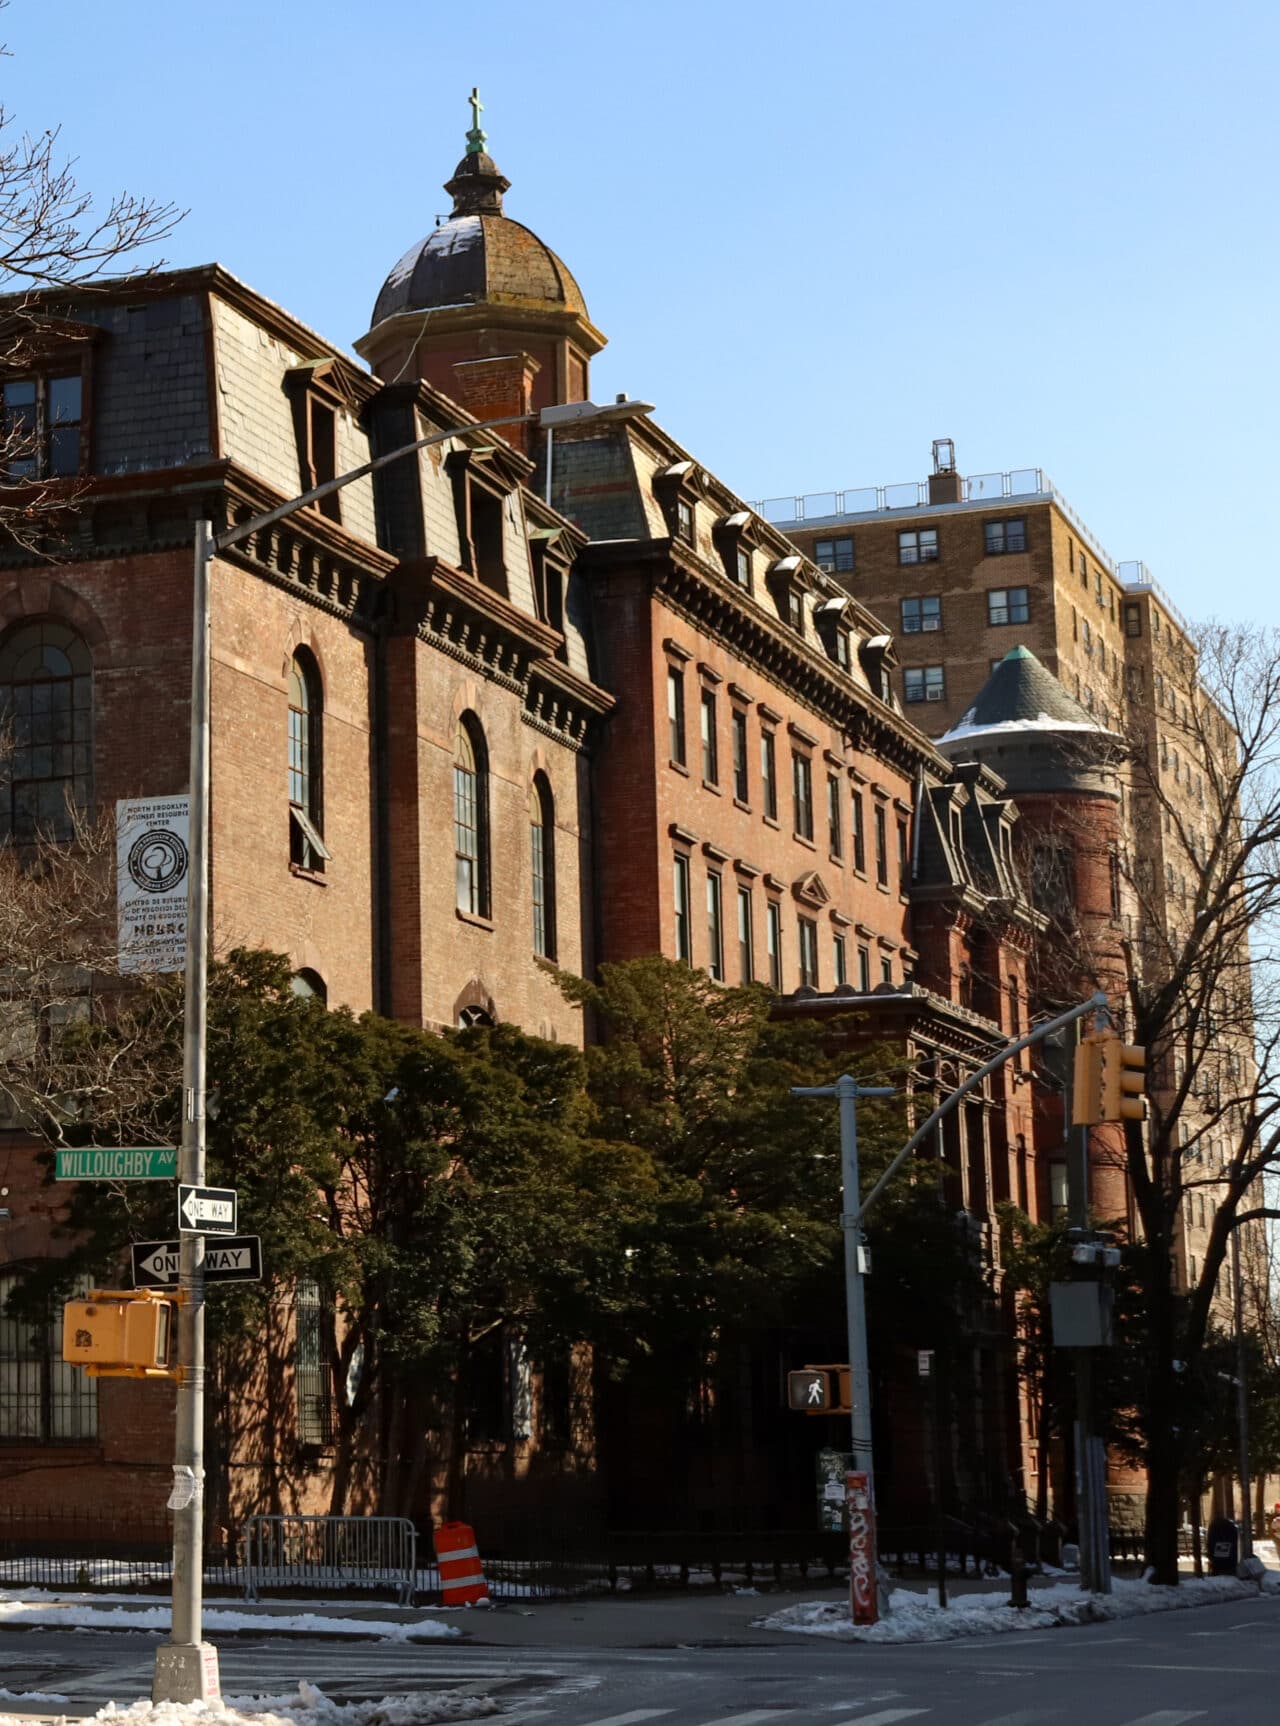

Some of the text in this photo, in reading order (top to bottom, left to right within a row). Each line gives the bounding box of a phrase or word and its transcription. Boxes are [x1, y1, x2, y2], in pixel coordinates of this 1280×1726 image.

[61, 1152, 175, 1176] WILLOUGHBY AV
[188, 1200, 229, 1218] ONE WAY
[153, 1251, 242, 1272] ON WAY
